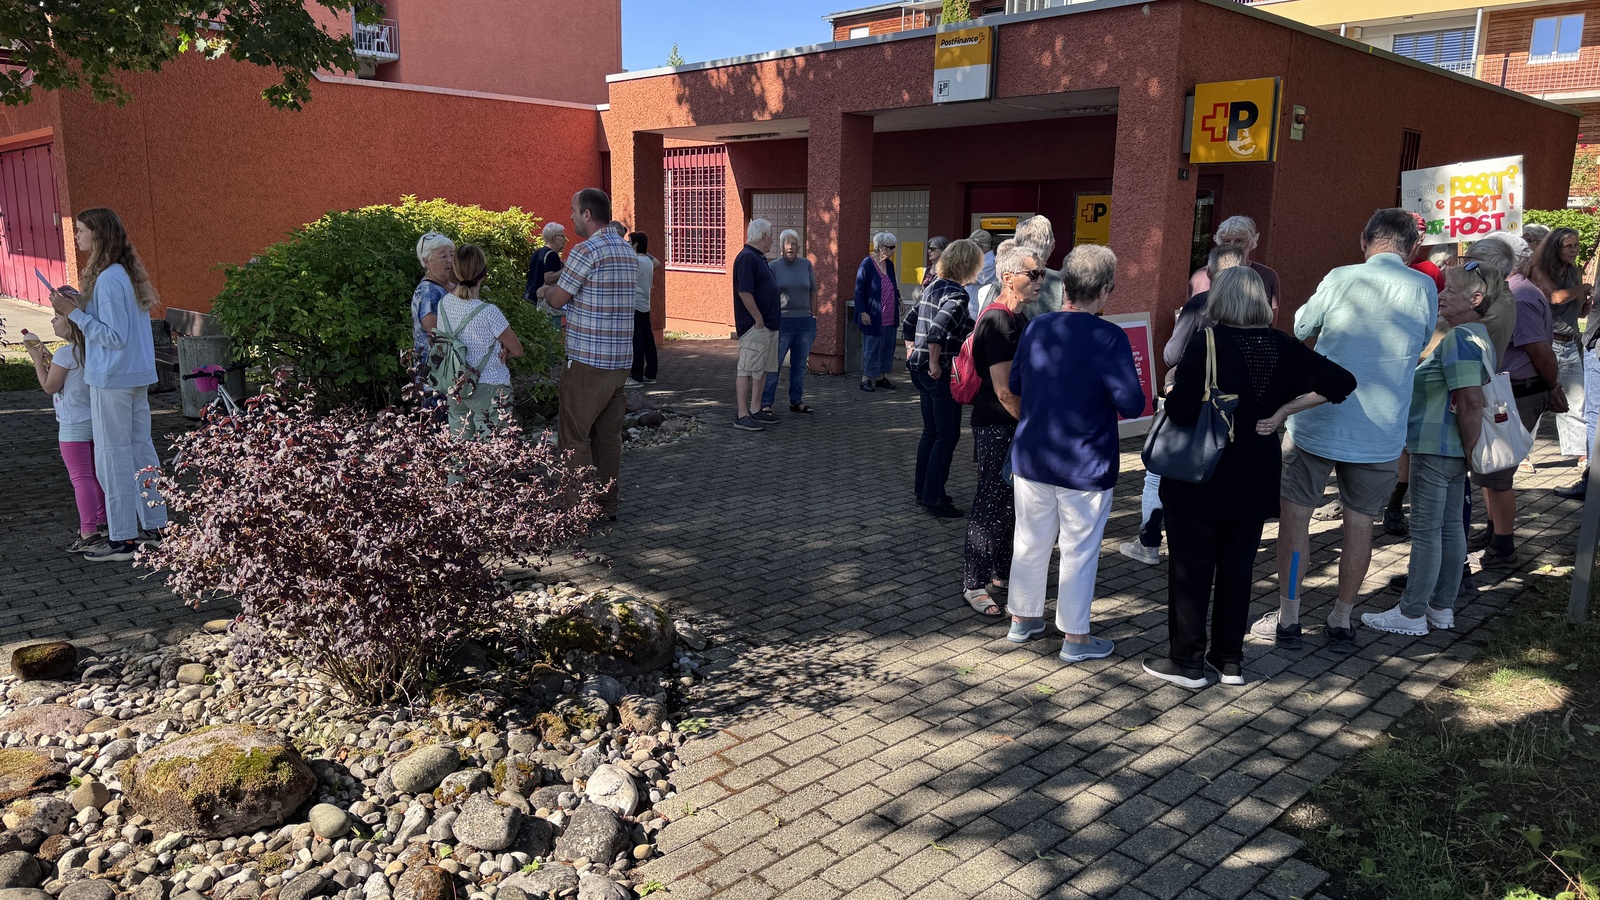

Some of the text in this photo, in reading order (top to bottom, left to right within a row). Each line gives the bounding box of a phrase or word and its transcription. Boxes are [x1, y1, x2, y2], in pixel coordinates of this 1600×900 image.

[940, 35, 978, 47] PostFinance
[1227, 101, 1259, 141] P
[1093, 202, 1108, 223] P
